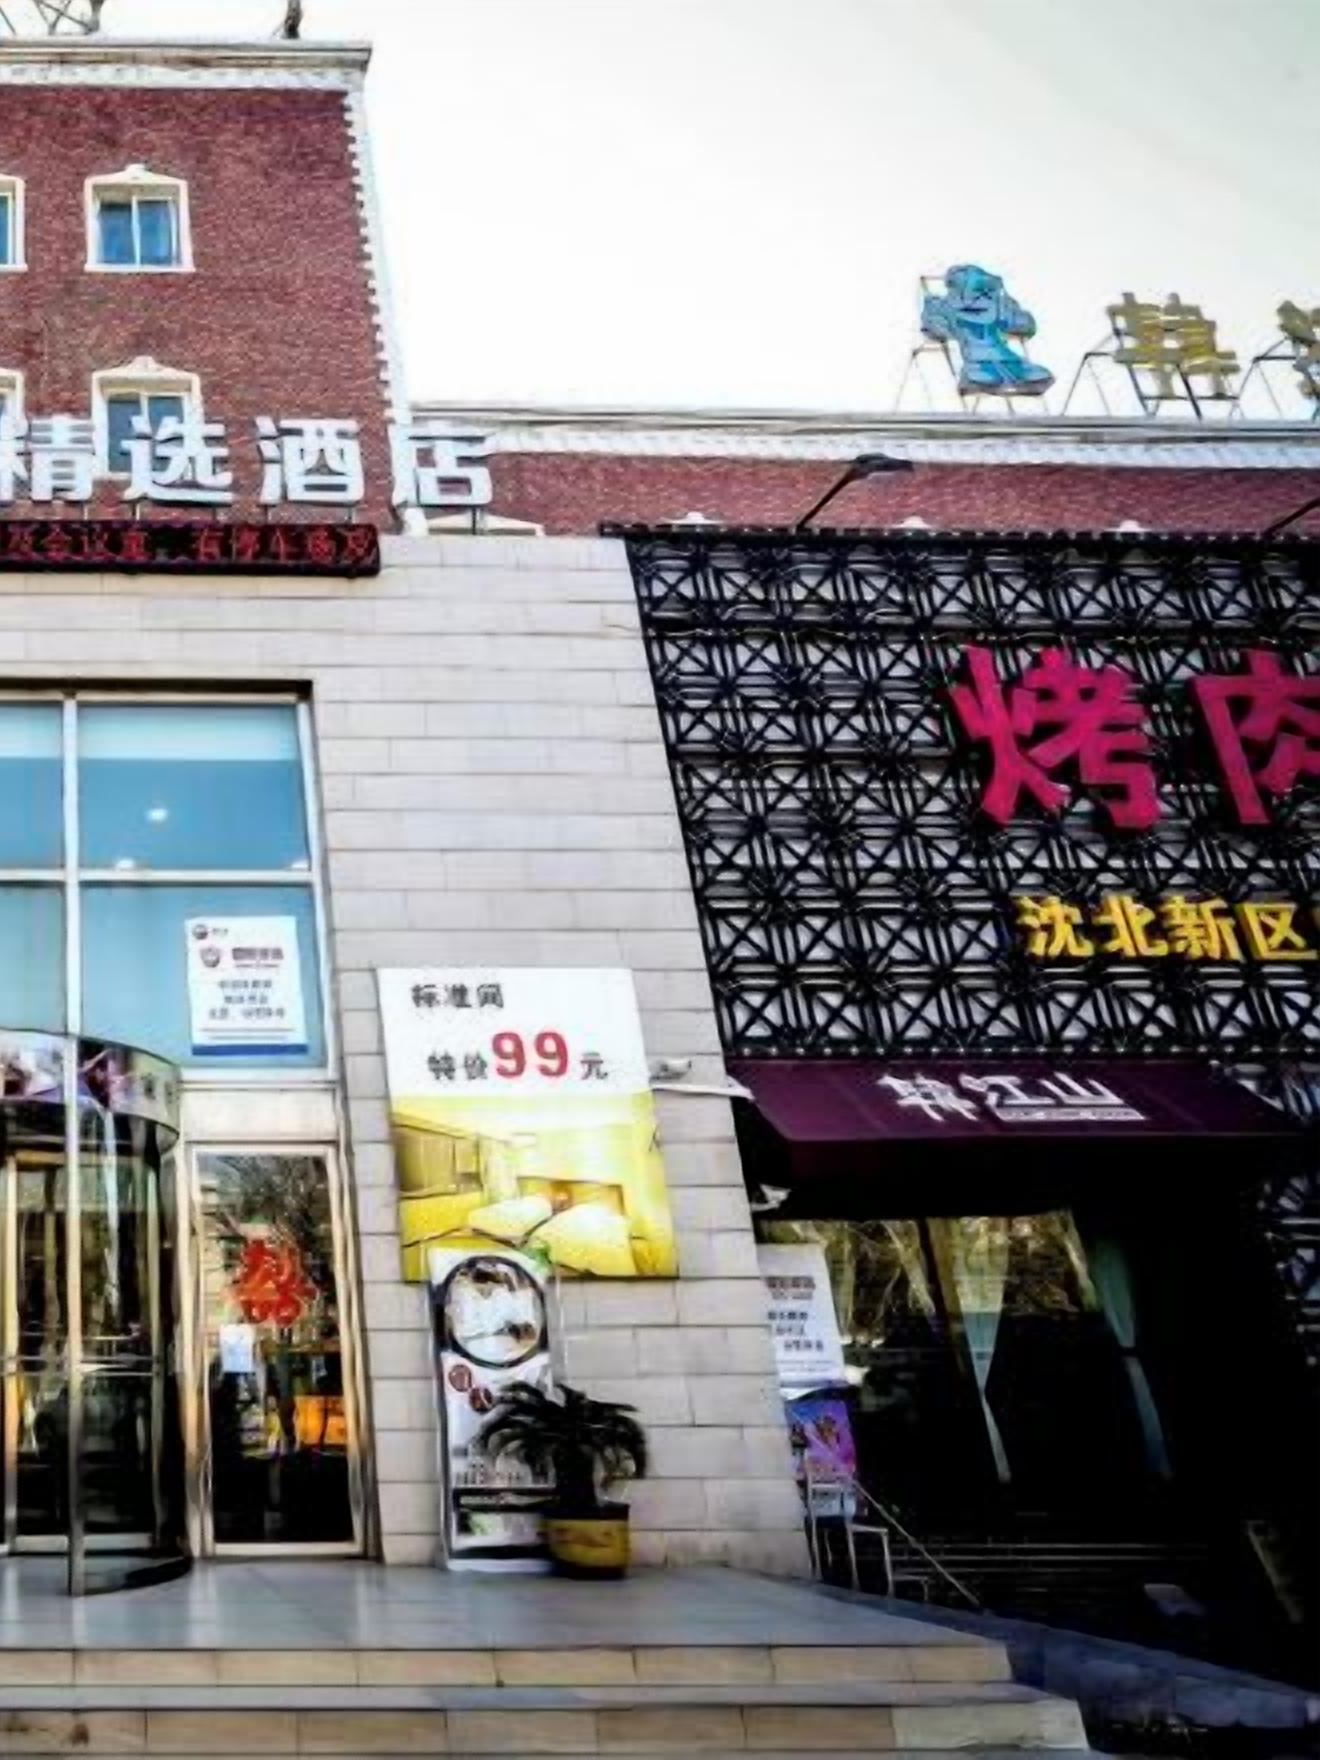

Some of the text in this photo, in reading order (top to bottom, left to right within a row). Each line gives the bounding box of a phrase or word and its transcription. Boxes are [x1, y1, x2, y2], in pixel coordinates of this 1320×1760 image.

[952, 643, 1320, 829] 烤肉
[1017, 894, 1318, 961] 沈北新区
